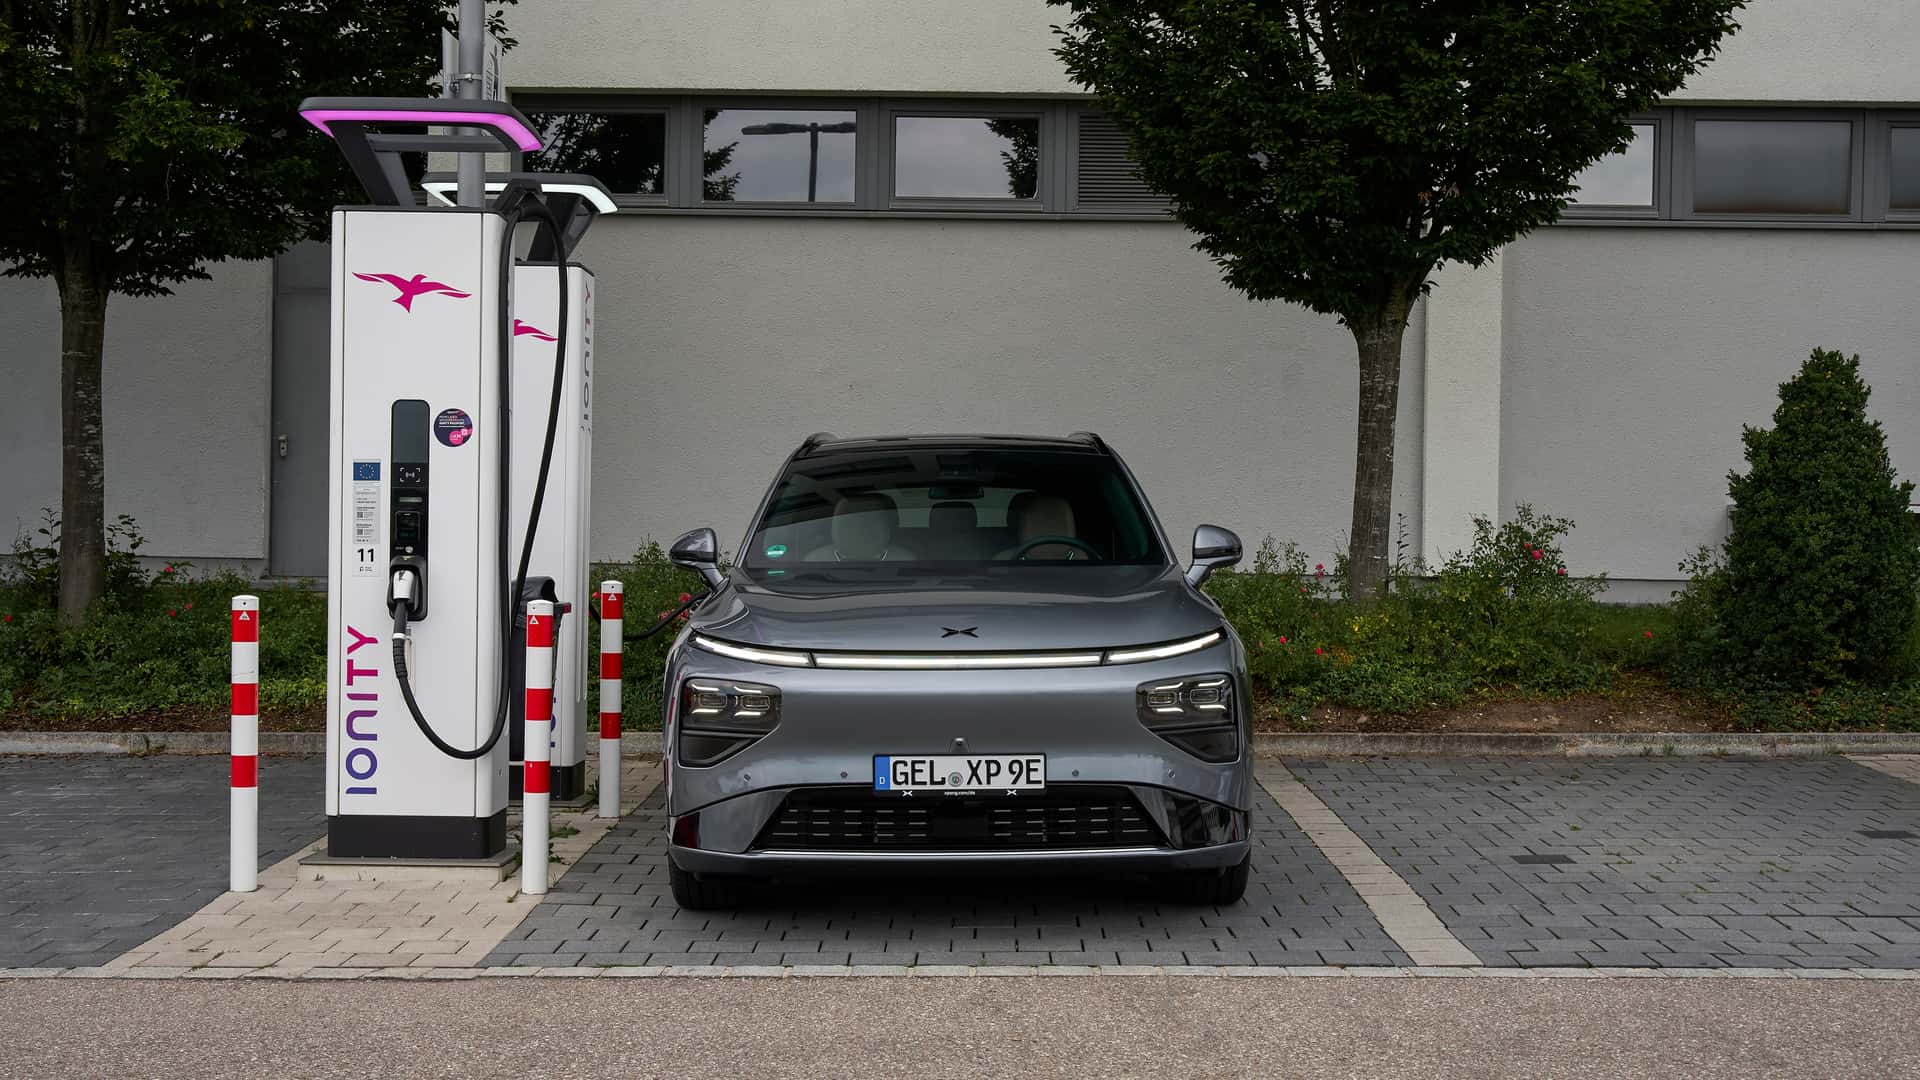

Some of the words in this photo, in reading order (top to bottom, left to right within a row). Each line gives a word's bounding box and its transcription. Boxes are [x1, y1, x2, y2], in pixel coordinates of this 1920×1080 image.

[357, 548, 374, 562] 11
[346, 625, 378, 795] IONITY
[879, 776, 885, 785] D
[892, 760, 946, 785] GEL
[966, 760, 1001, 785] XP
[1008, 759, 1042, 785] 9E
